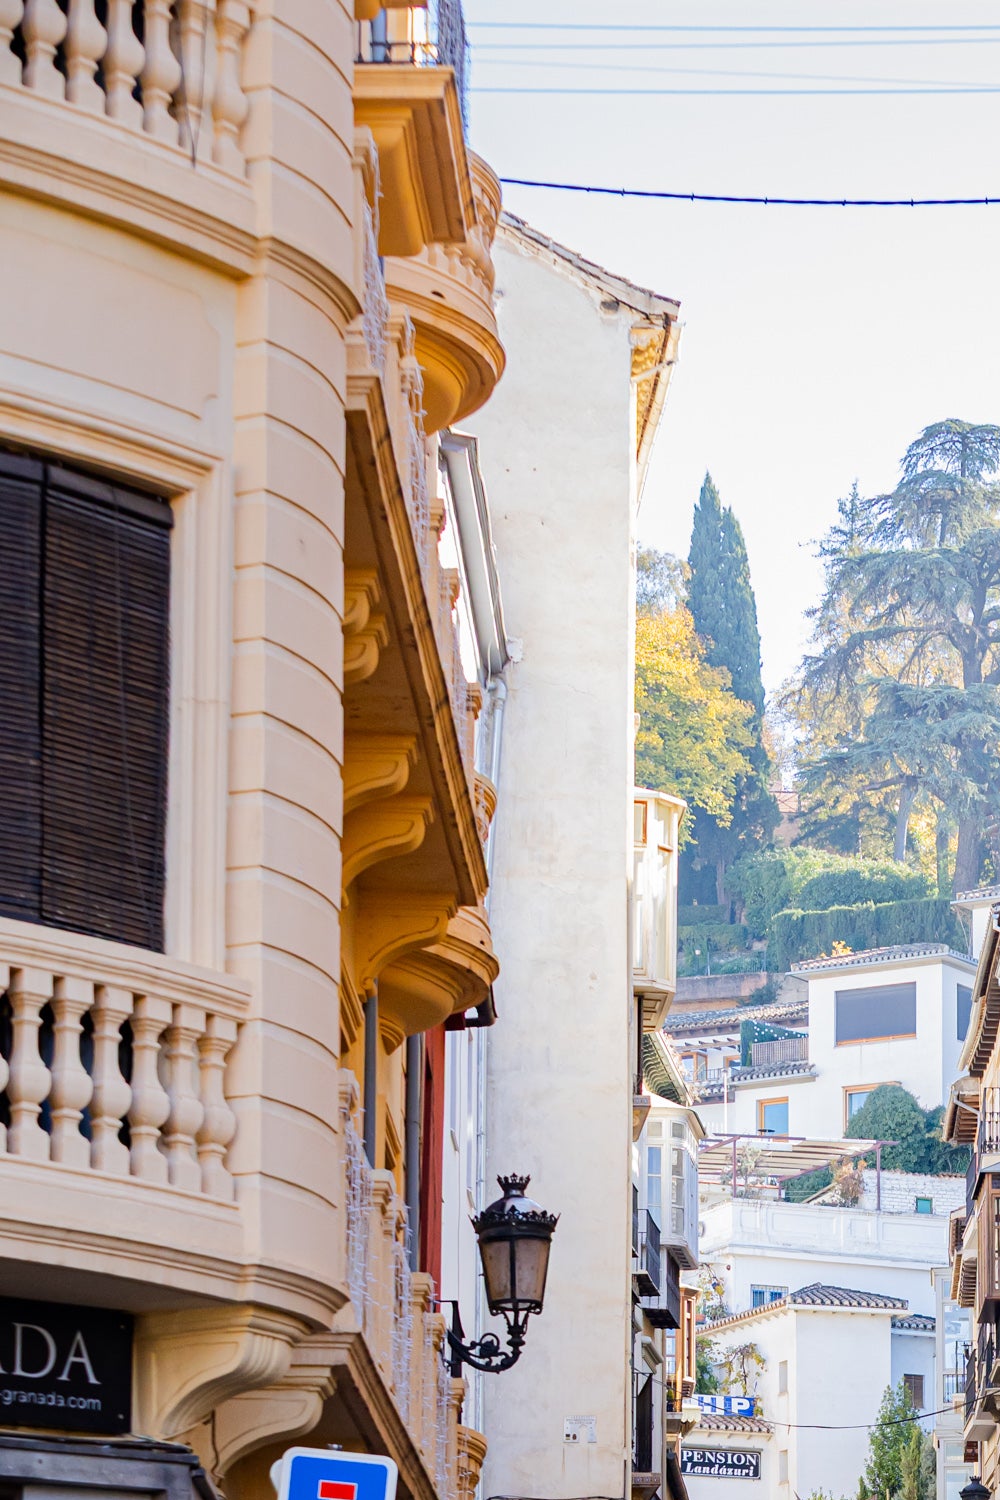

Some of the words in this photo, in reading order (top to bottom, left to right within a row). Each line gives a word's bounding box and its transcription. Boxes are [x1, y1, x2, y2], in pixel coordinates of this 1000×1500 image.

[0, 1322, 102, 1385] DA
[682, 1450, 757, 1466] PENSION
[685, 1462, 754, 1477] Landázuri
